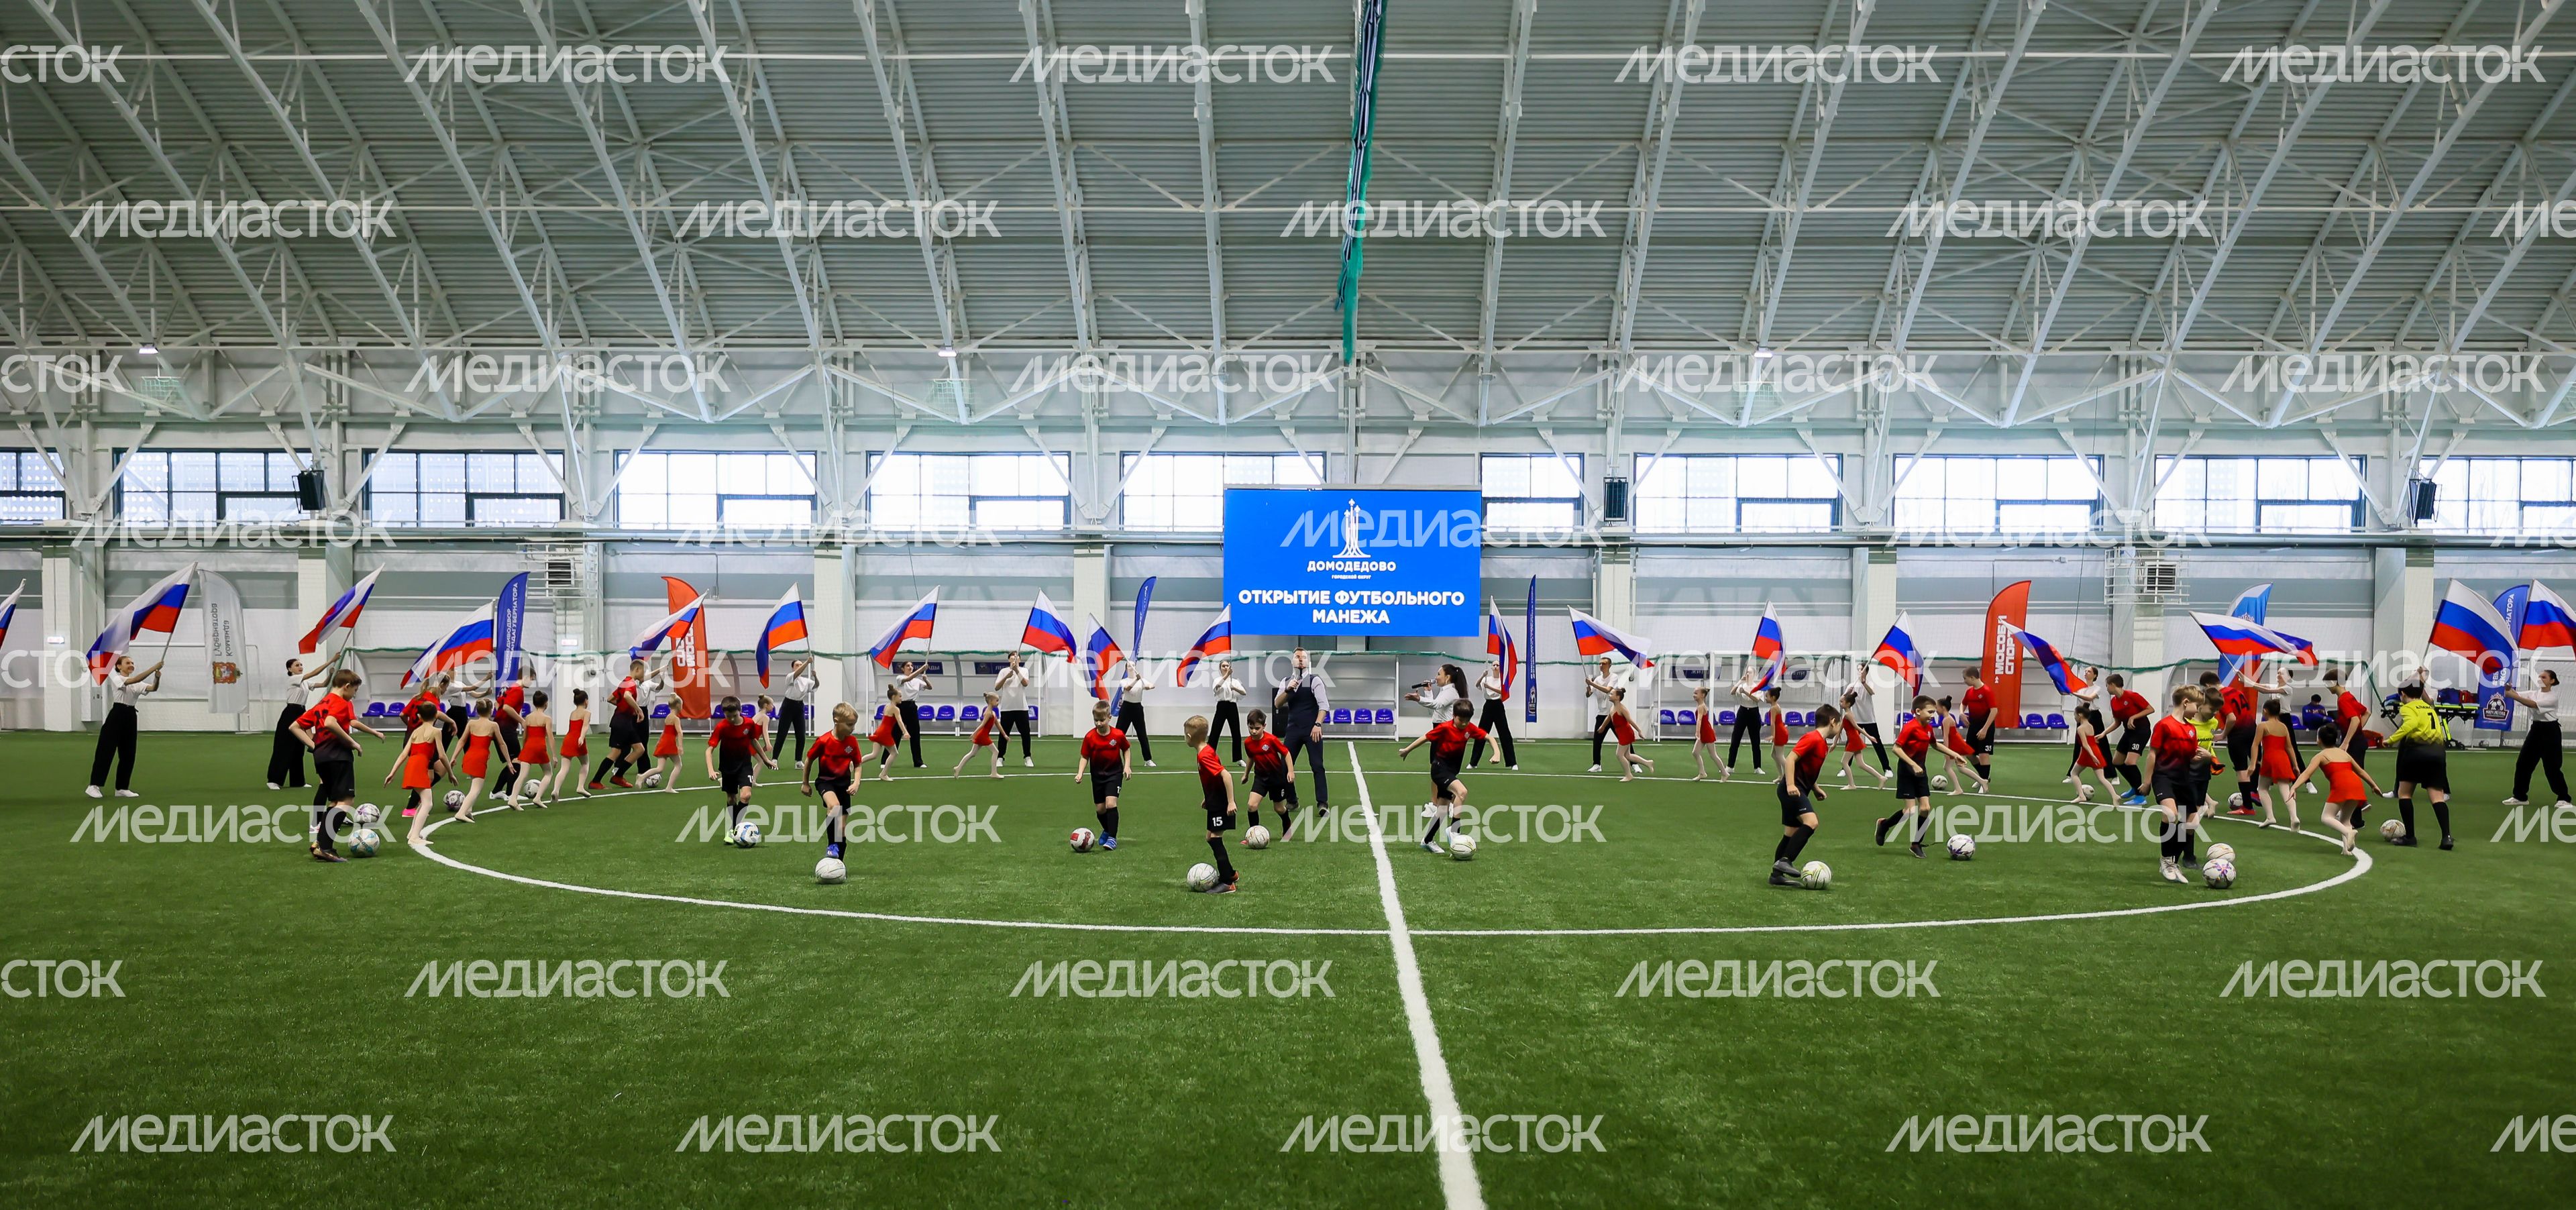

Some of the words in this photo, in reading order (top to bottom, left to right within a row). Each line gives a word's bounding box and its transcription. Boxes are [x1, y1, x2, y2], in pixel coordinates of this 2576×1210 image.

[1307, 561, 1396, 572] ДОМОДЕДОВО
[1238, 590, 1330, 604] ОТКРЫТИЕ
[1334, 590, 1464, 605] ФУТБОЛЬНОГО
[1313, 609, 1390, 624] МАНЕЖА
[1212, 816, 1223, 826] 15
